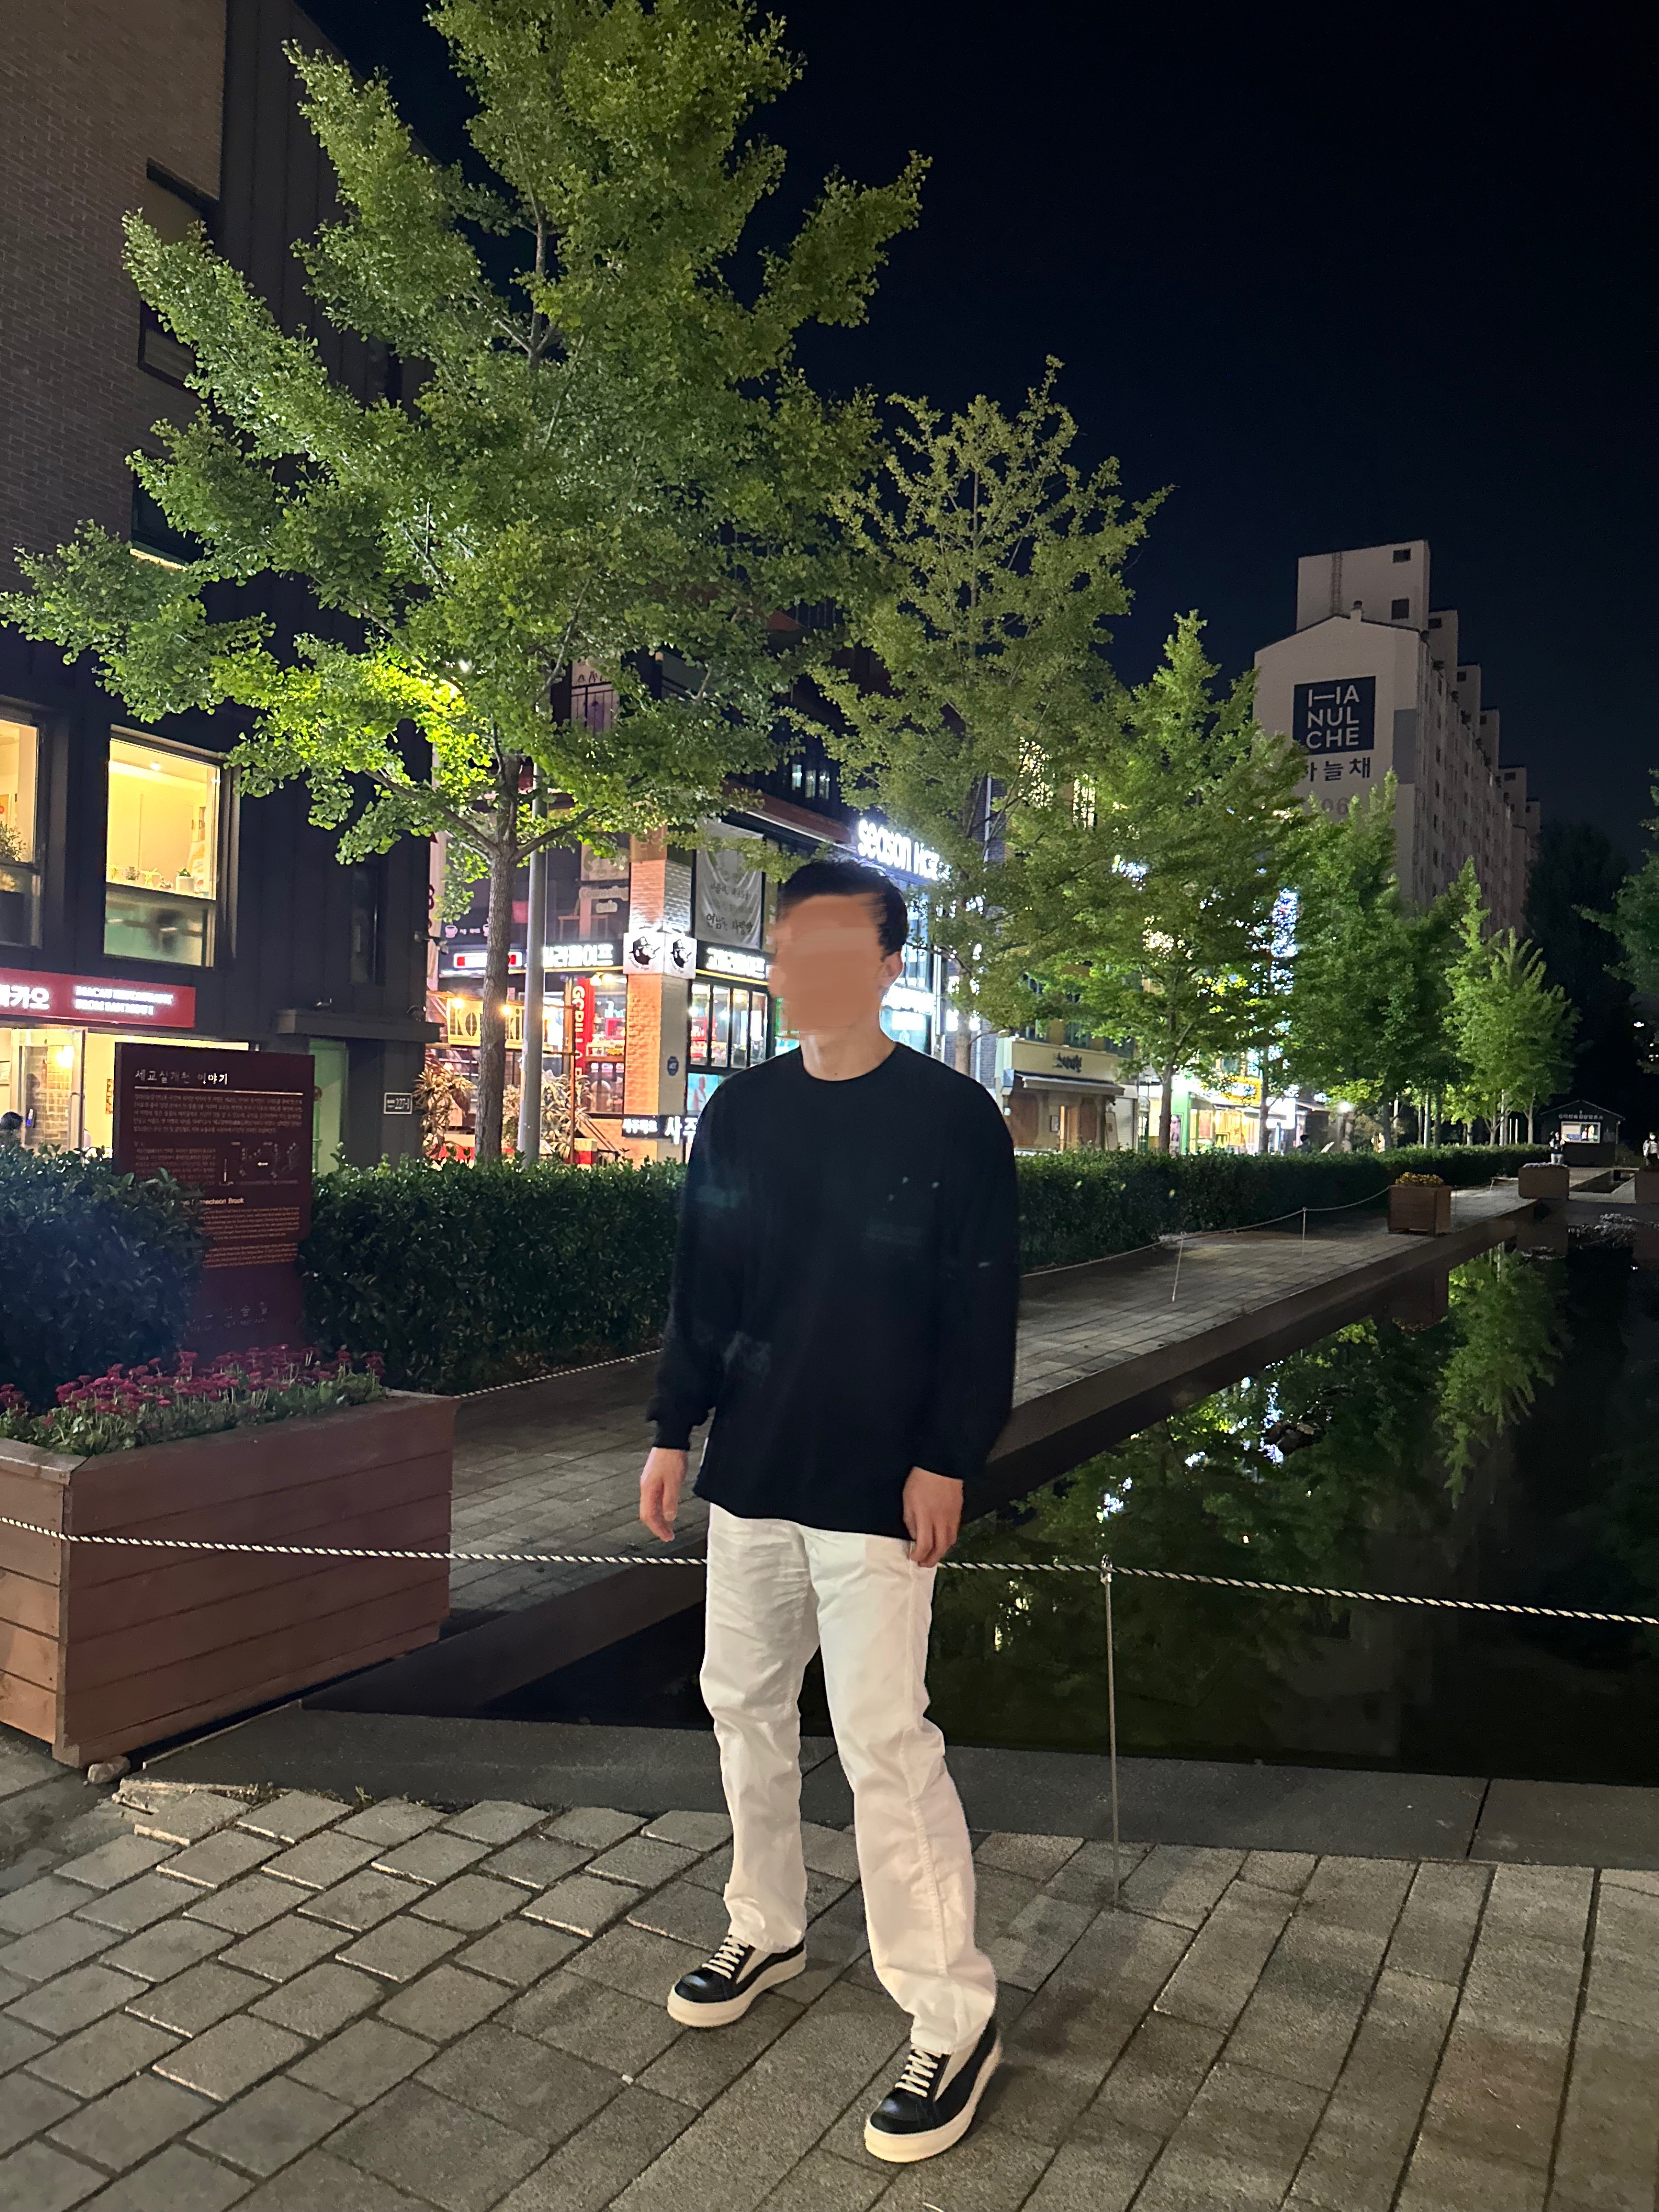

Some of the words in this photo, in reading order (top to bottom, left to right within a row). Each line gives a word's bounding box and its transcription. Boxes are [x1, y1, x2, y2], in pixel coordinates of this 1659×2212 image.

[1308, 685, 1360, 708] HA
[1307, 706, 1359, 729] NUL
[1306, 726, 1359, 749] CHE
[198, 1072, 228, 1085] 이야기
